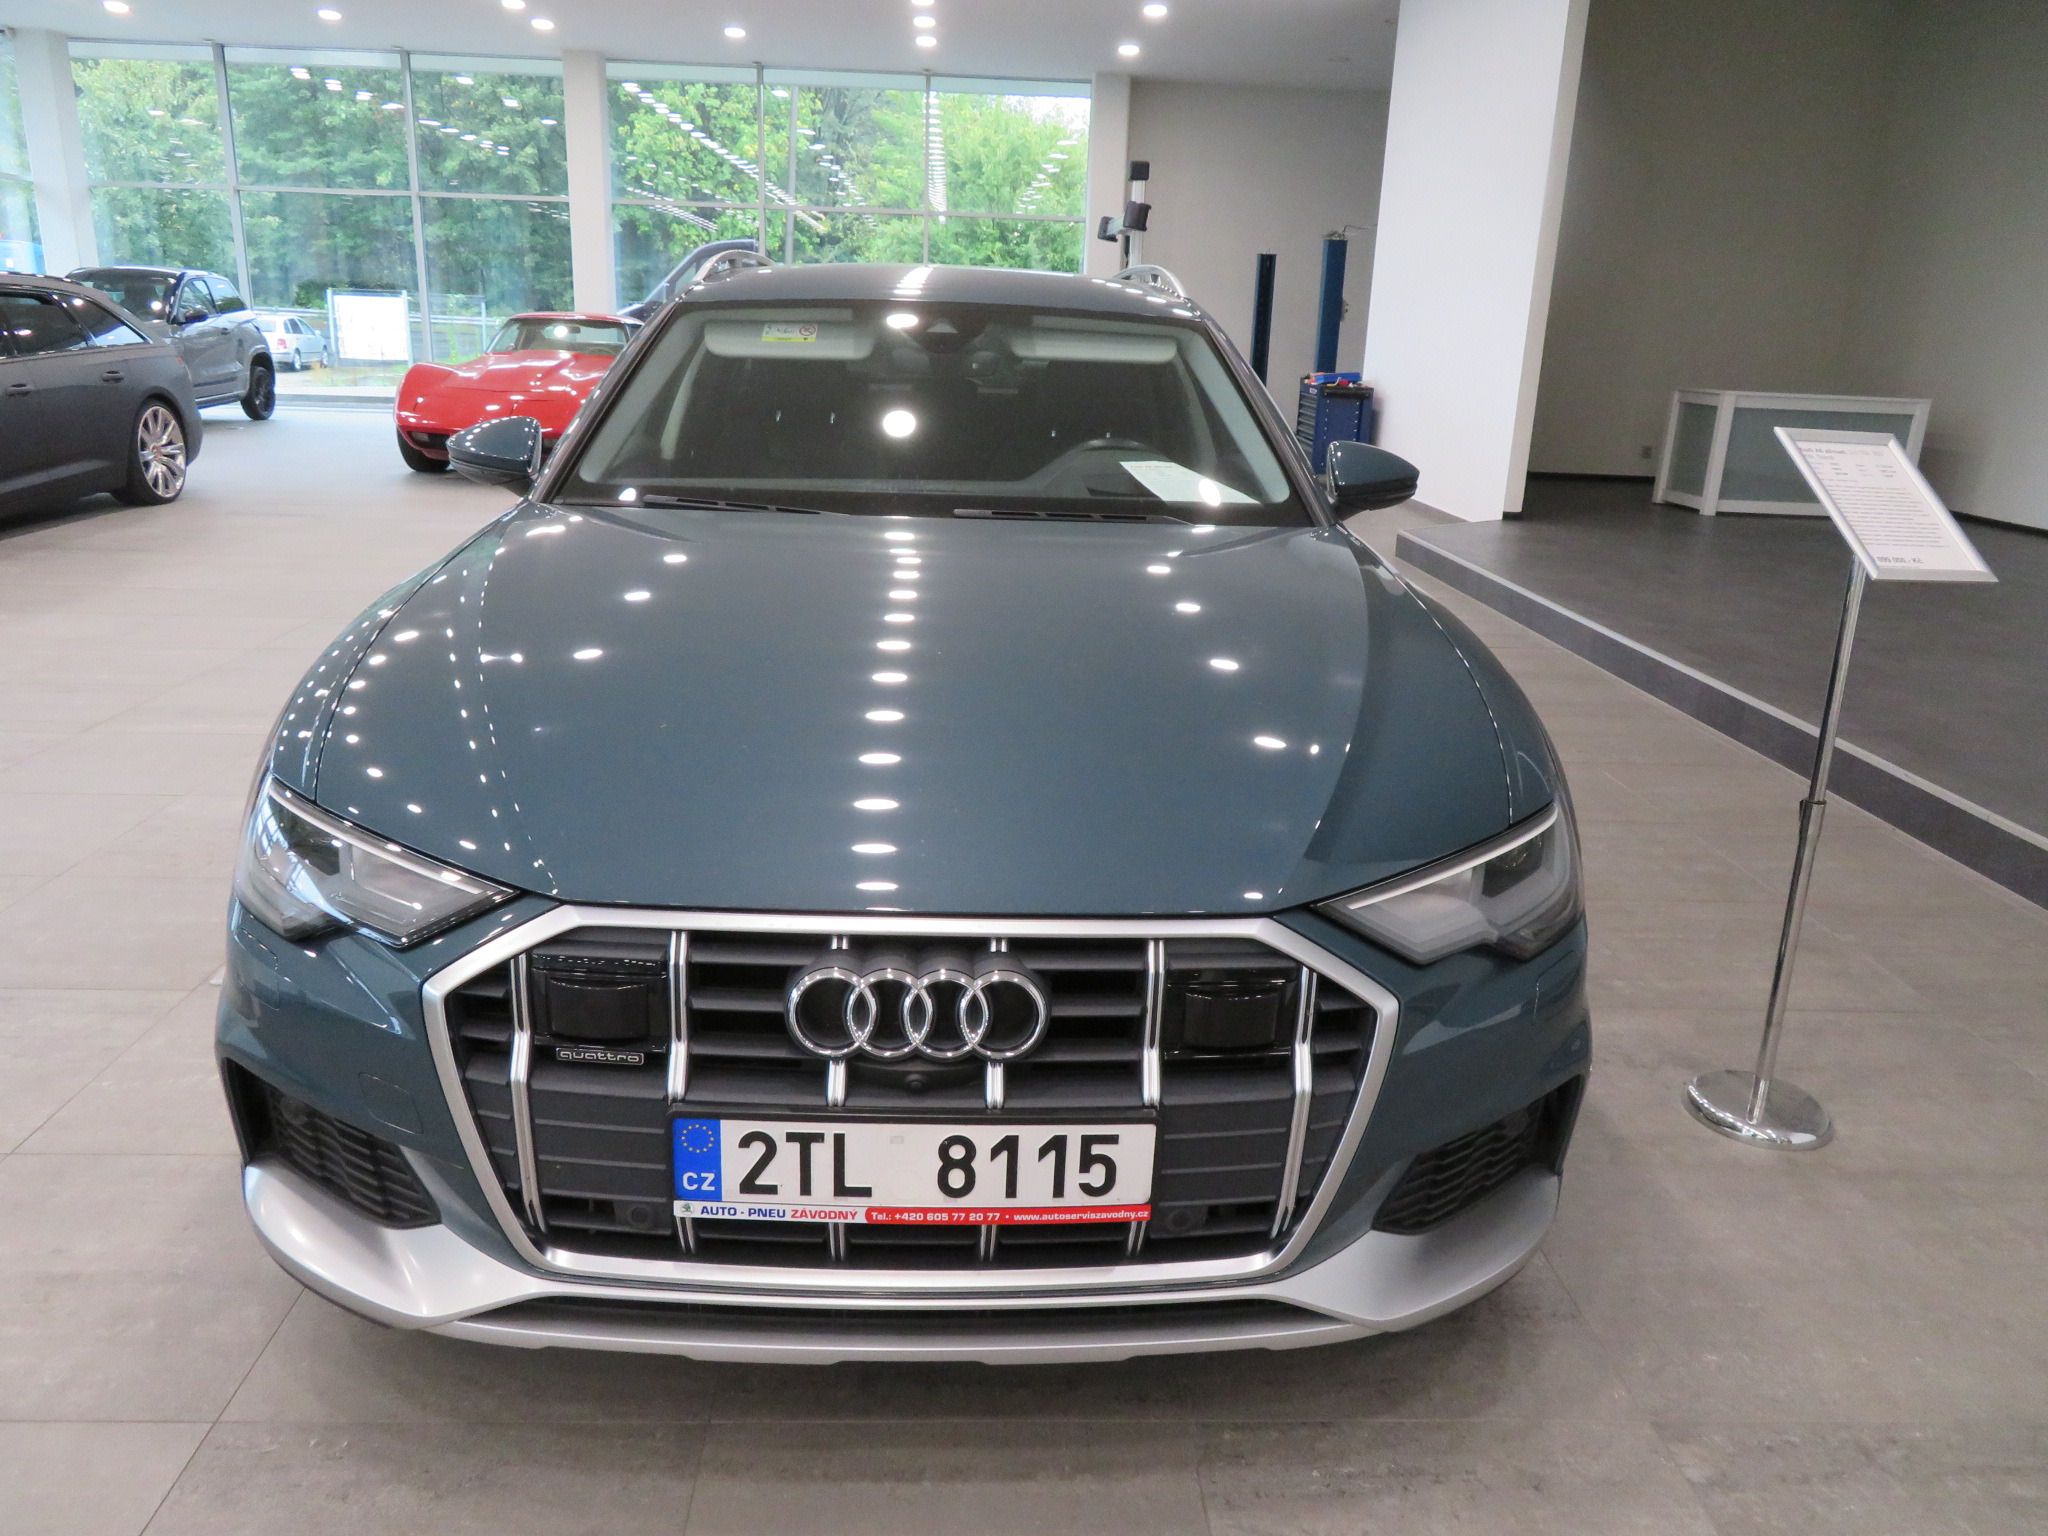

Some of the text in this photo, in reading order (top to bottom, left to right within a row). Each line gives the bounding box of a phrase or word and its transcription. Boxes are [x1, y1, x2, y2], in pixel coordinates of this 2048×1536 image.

[560, 1051, 639, 1062] quattro
[738, 1131, 1119, 1198] 2TL 8115
[682, 1172, 715, 1190] CZ
[700, 1205, 737, 1216] AUTO
[748, 1207, 786, 1218] PNEU
[790, 1207, 857, 1220] ZÁVODNÝ
[894, 1212, 924, 1221] +420
[926, 1212, 949, 1221] 605
[951, 1213, 966, 1221] 77
[968, 1213, 984, 1221] 20
[986, 1213, 1000, 1221] 77
[1013, 1210, 1149, 1220] www.autoserviszavodny.cz
